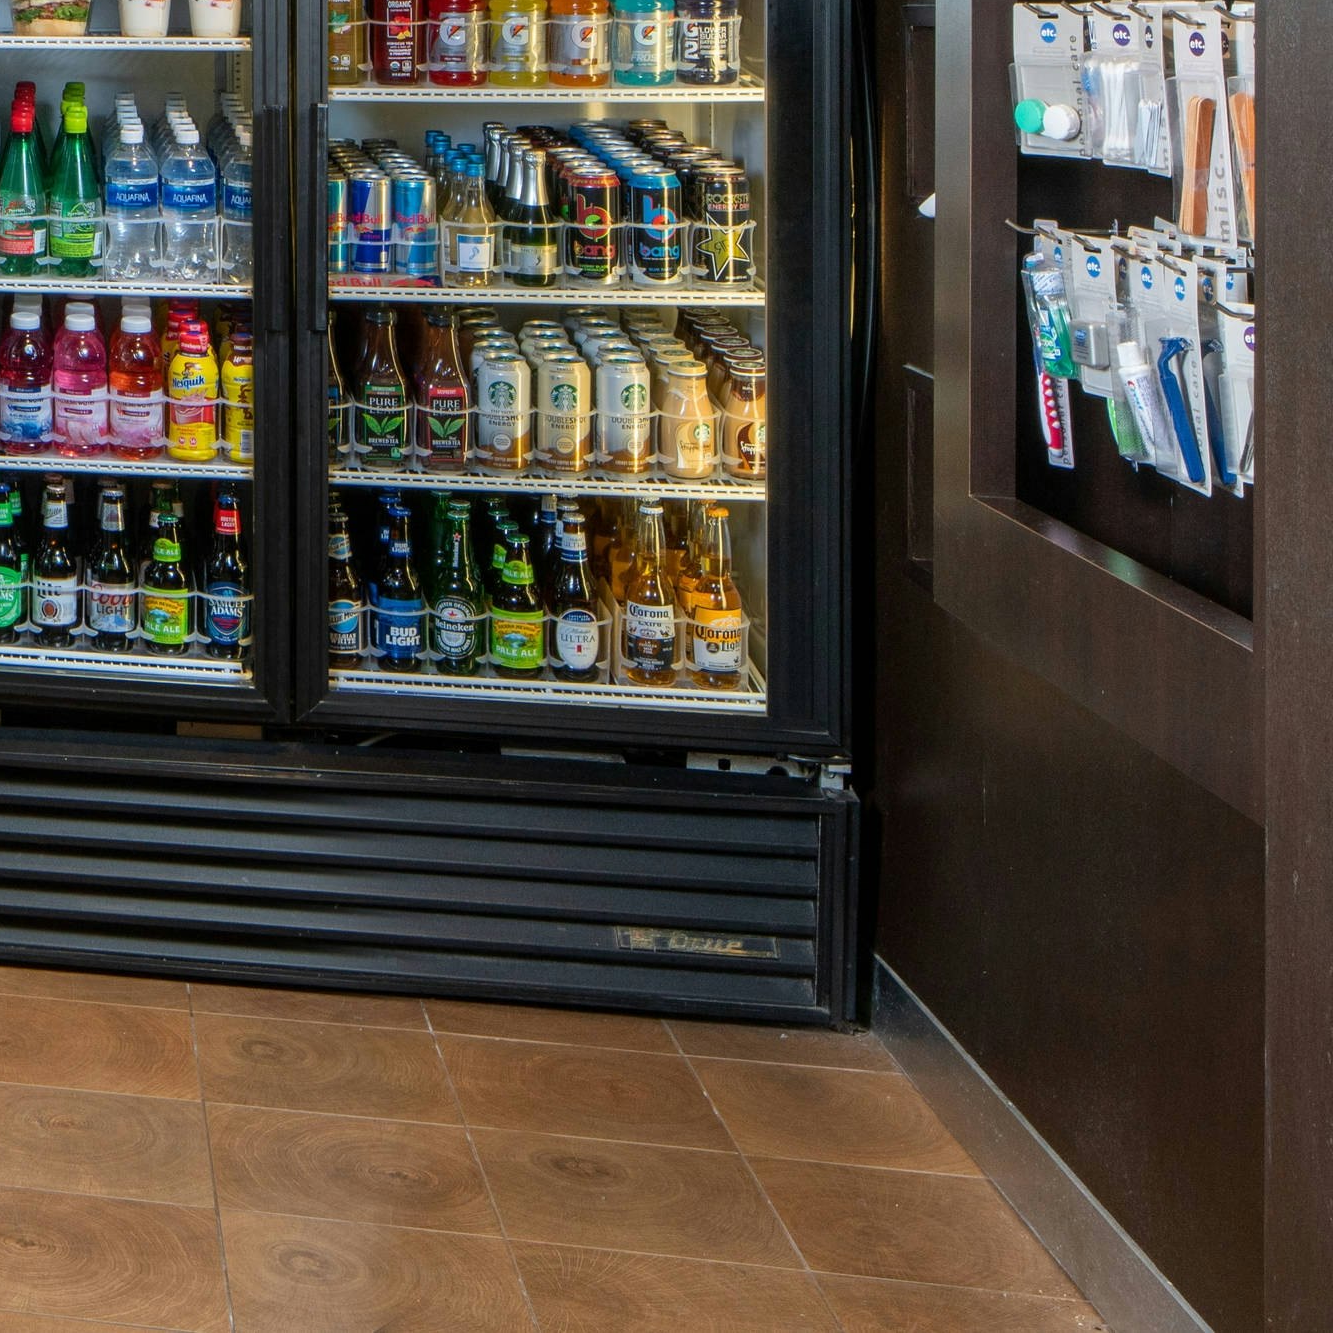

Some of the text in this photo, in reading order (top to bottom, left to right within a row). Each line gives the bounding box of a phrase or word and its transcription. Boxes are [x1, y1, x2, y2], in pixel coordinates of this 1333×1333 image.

[1041, 28, 1057, 37] etc.
[1114, 30, 1131, 40] etc.
[1190, 39, 1205, 50] etc.
[631, 53, 659, 62] FROS
[1069, 35, 1086, 157] peronal care
[116, 192, 151, 202] AQUAFINA
[173, 193, 208, 203] AQUAFINA
[705, 194, 749, 204] ROCKST
[1214, 154, 1230, 244] misc.
[396, 213, 436, 224] Red Bull
[574, 240, 615, 259] bang
[640, 241, 680, 259] bang
[1087, 263, 1101, 272] etc.
[328, 277, 382, 287] ed Bull
[1141, 273, 1153, 283] etc.
[1175, 284, 1186, 294] etc.
[173, 375, 205, 389] Nesquik
[369, 397, 398, 406] PURE
[433, 399, 460, 408] PURE
[211, 606, 243, 617] ADAMS
[629, 604, 669, 618] Corona
[163, 625, 180, 633] ALE
[436, 617, 474, 631] Heineken
[390, 626, 417, 637] BUD
[386, 635, 420, 646] LIGHT
[560, 633, 595, 643] ULTRA
[496, 645, 538, 658] PALE ALE
